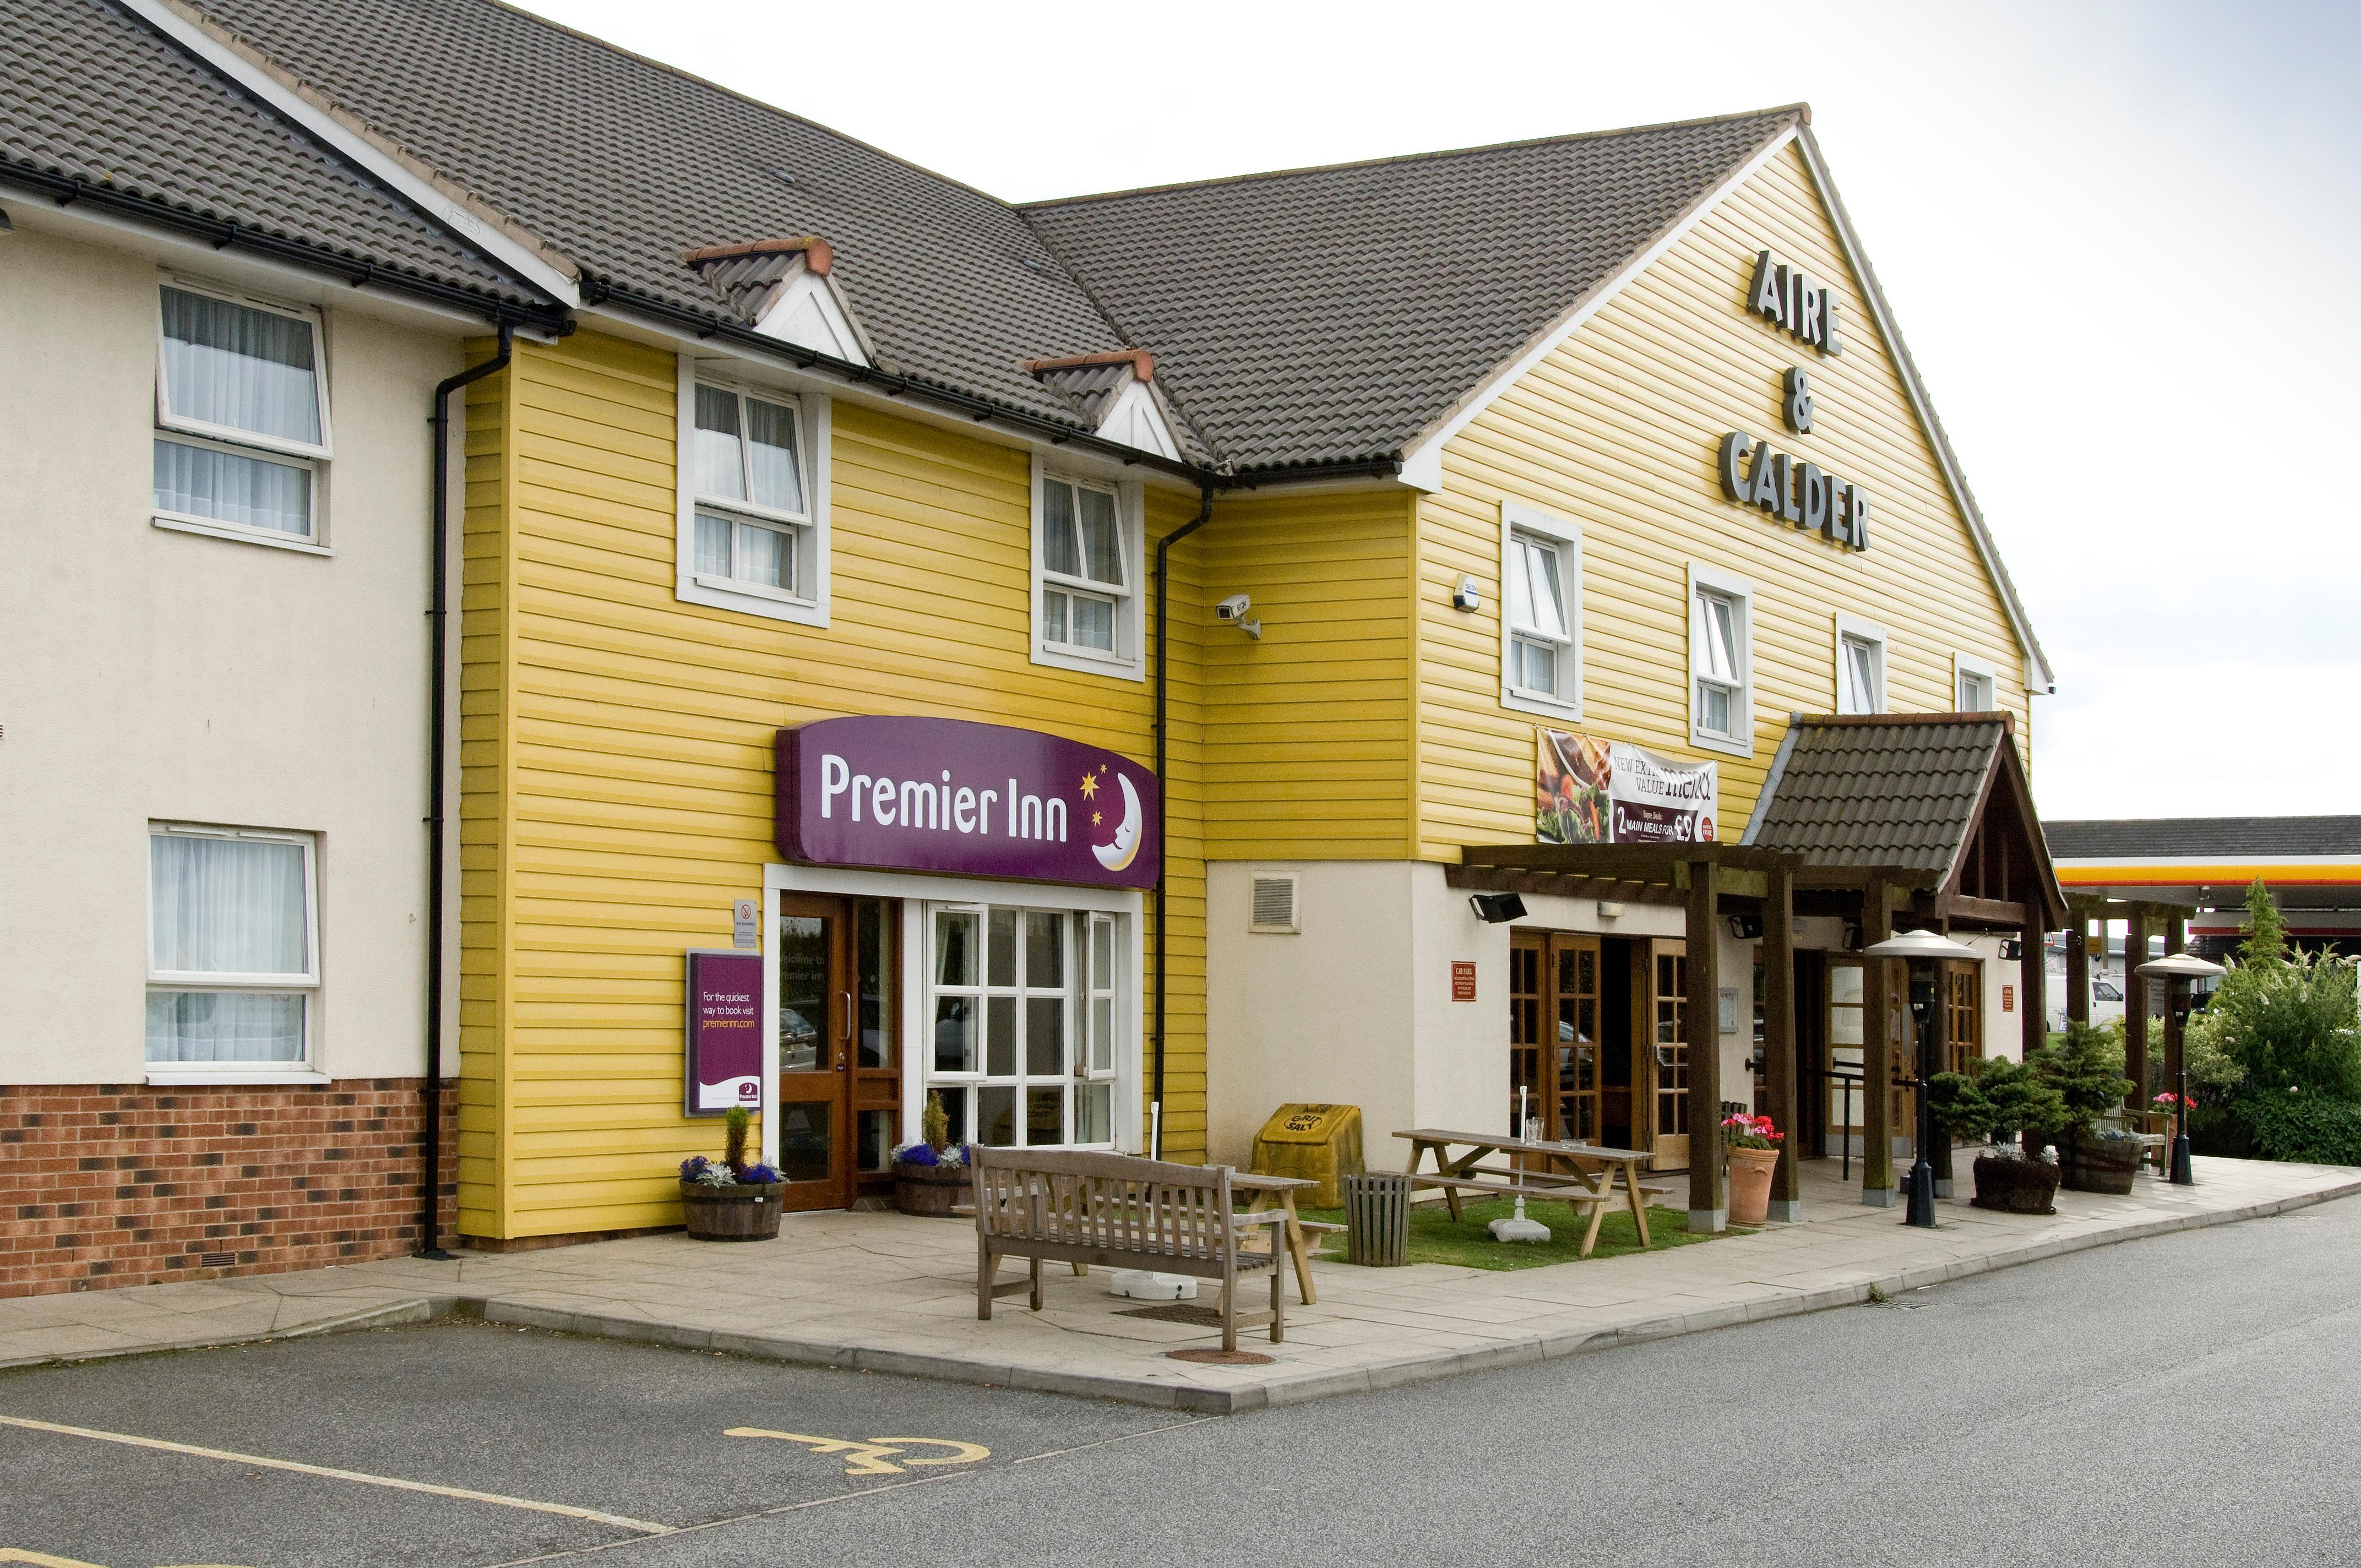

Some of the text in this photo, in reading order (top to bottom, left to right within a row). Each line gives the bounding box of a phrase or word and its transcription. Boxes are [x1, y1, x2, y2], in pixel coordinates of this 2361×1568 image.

[1747, 250, 1842, 357] AIRE
[1782, 367, 1814, 434] &
[1718, 431, 1870, 552] CALDER
[1613, 756, 1633, 772] NEW
[1636, 777, 1664, 794] VALUE
[821, 754, 1067, 842] Premier Inn
[1618, 807, 1693, 842] 2 MAIN MEALS FOR £9
[703, 992, 749, 1004] For the quickest
[703, 1005, 754, 1017] way to book visit
[703, 1017, 755, 1030] premierinn.com
[1286, 1122, 1314, 1131] SALT
